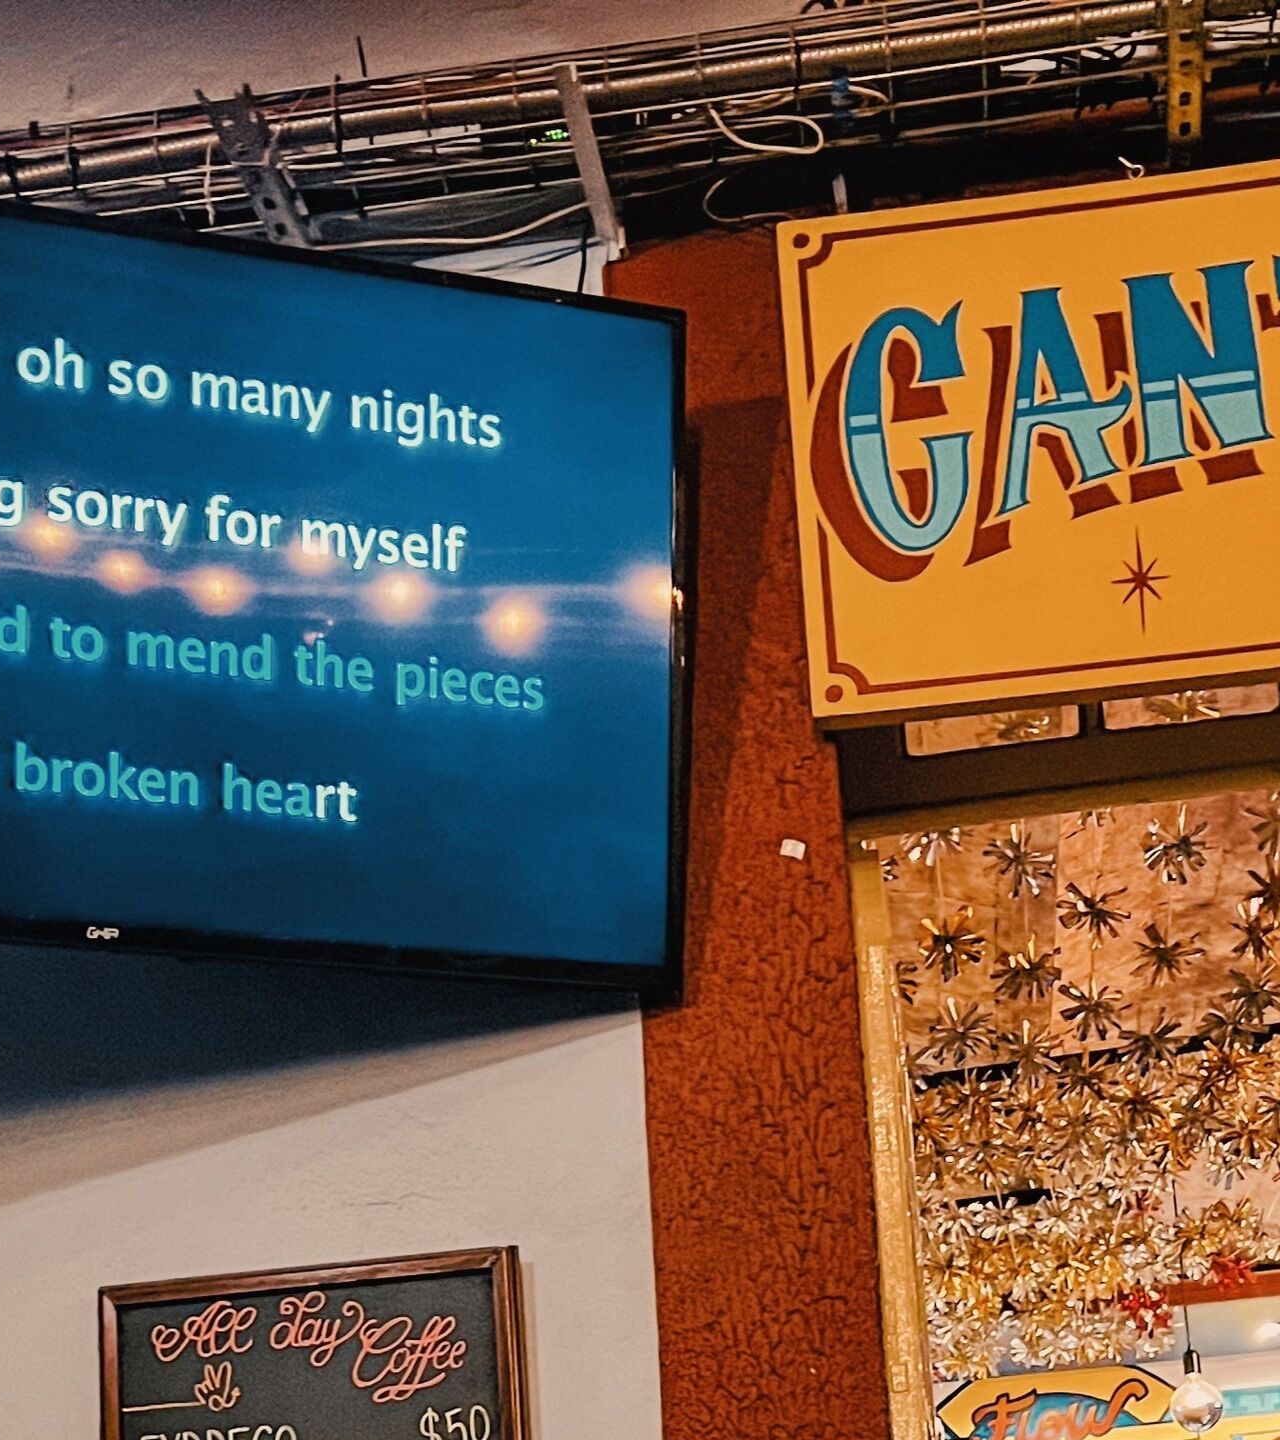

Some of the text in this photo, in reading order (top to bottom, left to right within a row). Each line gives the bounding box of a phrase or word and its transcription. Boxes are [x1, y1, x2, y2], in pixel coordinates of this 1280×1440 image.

[17, 337, 86, 390] oh
[108, 357, 168, 401] so
[190, 368, 331, 433] many
[350, 388, 502, 449] nights
[46, 484, 187, 546] sorry
[205, 494, 281, 549] for
[300, 513, 468, 572] myself
[50, 616, 106, 662] to
[127, 630, 273, 682] mend
[294, 638, 375, 693] the
[395, 656, 545, 712] pieces
[14, 740, 199, 806] broken
[222, 761, 358, 823] heart
[150, 1300, 257, 1361] All
[351, 1315, 467, 1402] Coffee
